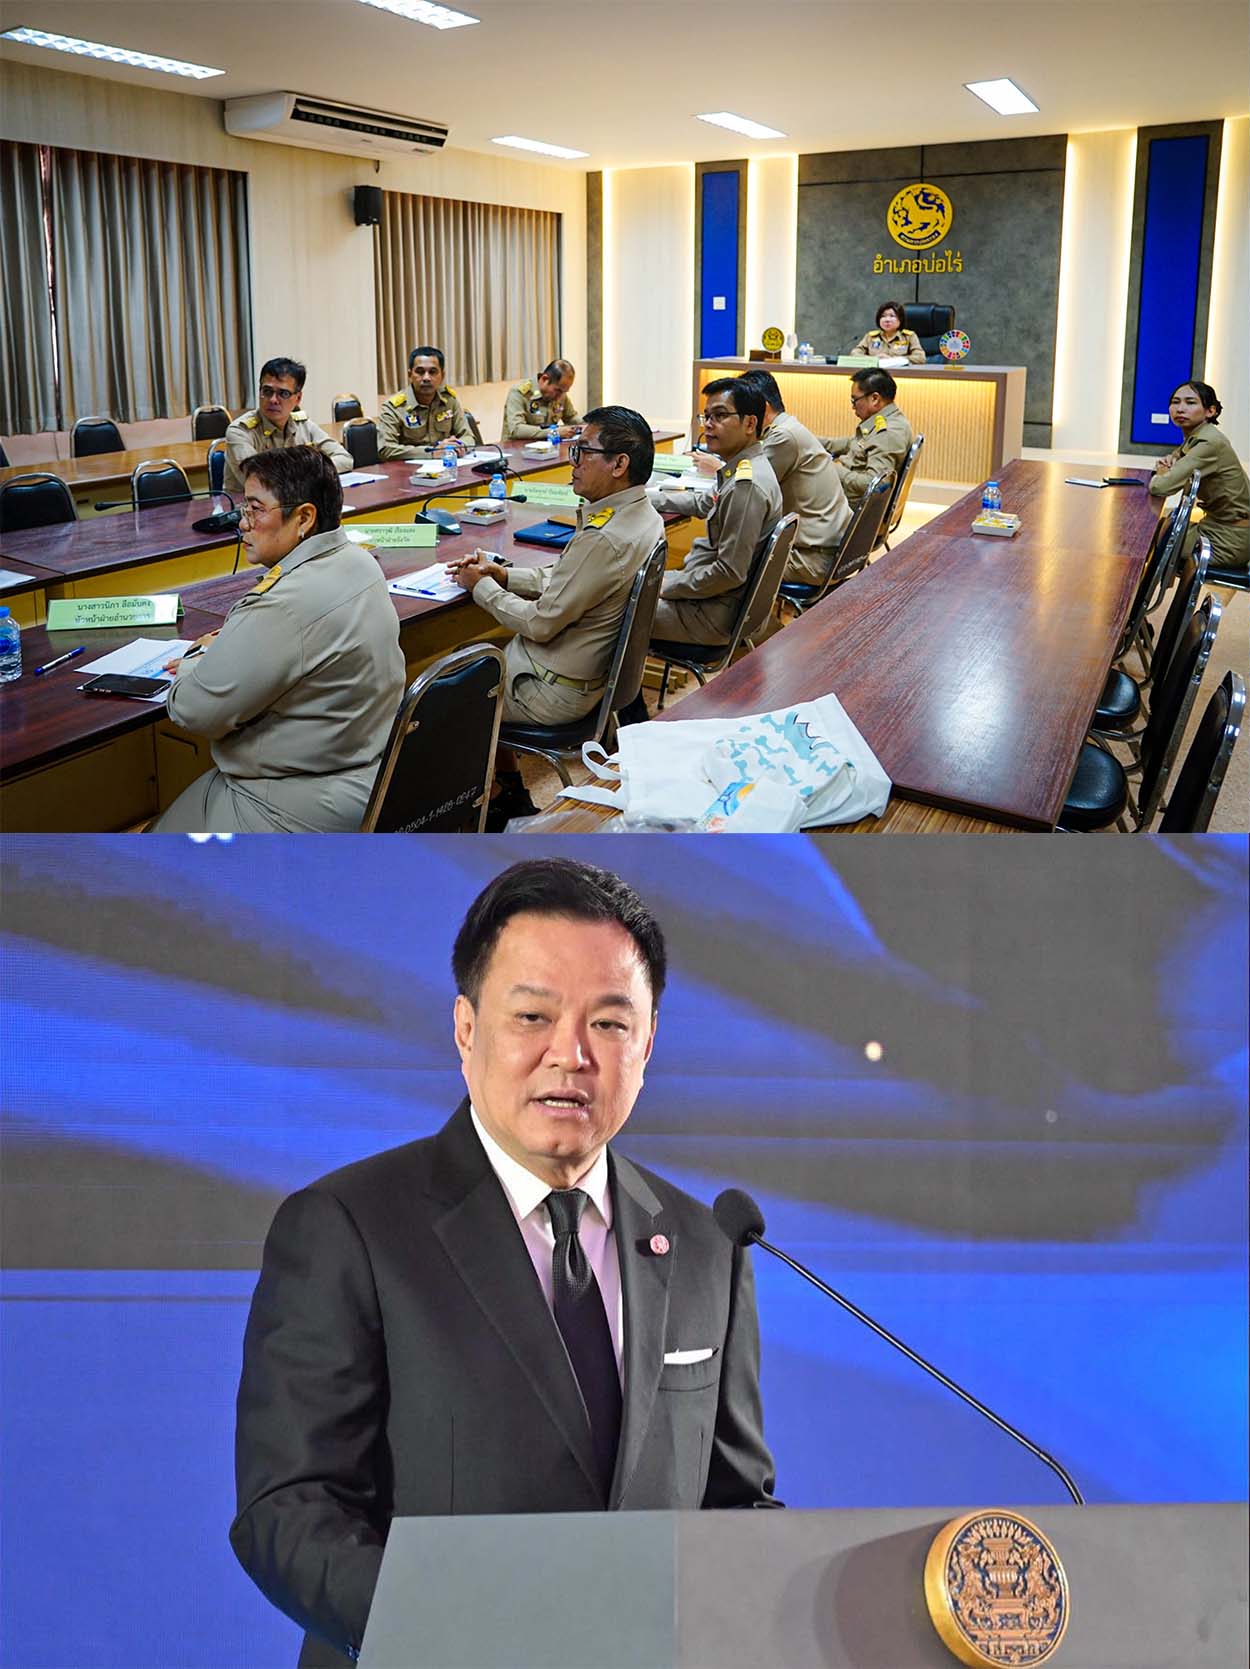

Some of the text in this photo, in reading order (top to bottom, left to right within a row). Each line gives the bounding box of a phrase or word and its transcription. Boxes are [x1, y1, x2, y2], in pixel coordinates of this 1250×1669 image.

[872, 250, 963, 273] อำเภอบ่อไร่
